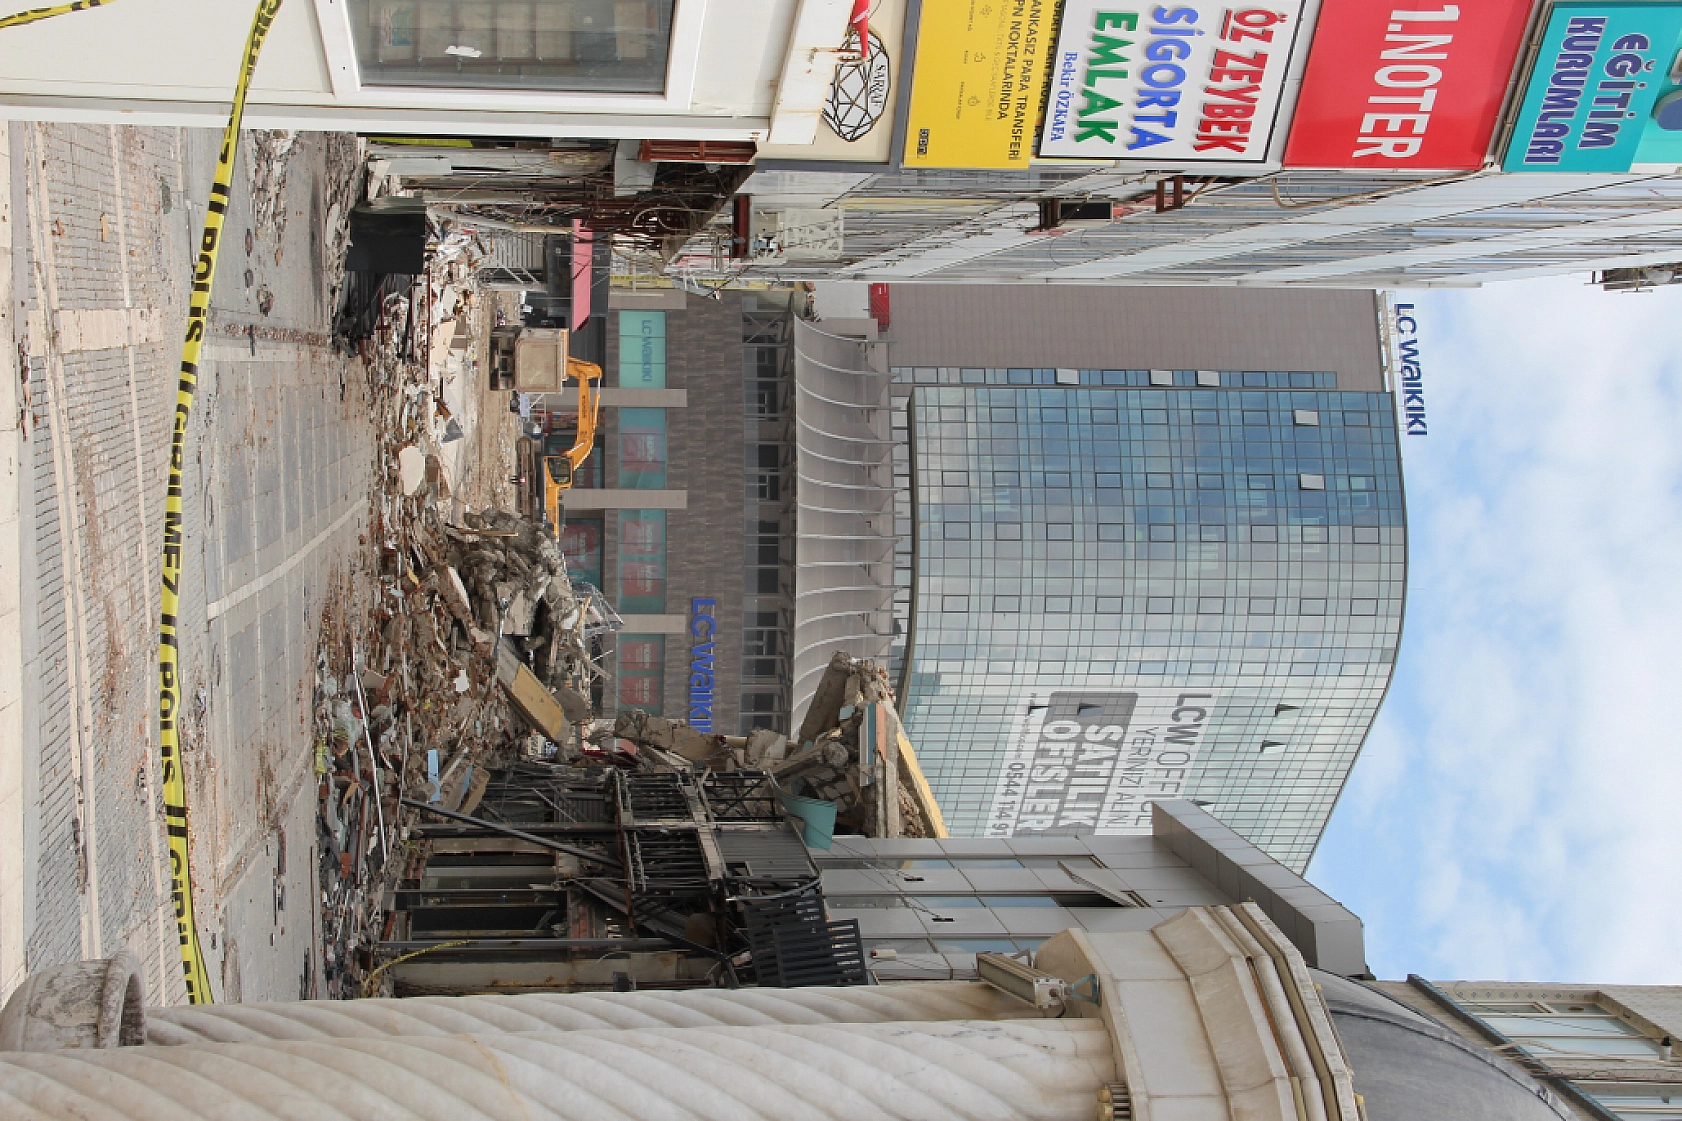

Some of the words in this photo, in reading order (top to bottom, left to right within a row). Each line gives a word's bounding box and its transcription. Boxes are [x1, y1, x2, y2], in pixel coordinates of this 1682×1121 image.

[1230, 9, 1288, 43] ÖZ
[996, 21, 1022, 121] NOKTALARINDA
[1017, 59, 1034, 92] PARA
[1060, 52, 1079, 87] Bekir
[1074, 11, 1139, 144] EMLAK
[1127, 6, 1205, 150] SİGORTA
[1193, 49, 1269, 153] ZEYBEK
[1352, 4, 1460, 158] 1.NOTER
[1523, 17, 1608, 165] KURUMLARI
[1577, 34, 1656, 149] EĞİTİM
[1008, 95, 1028, 160] TRANSFERİ
[1050, 90, 1074, 142] ÖZKAFA
[1394, 303, 1417, 335] LC
[691, 597, 717, 637] LC
[1164, 694, 1212, 746] LCW
[1001, 762, 1026, 797] 0544
[1015, 720, 1082, 831] OFİSLER
[1057, 724, 1124, 828] SATILIK
[1117, 727, 1159, 789] YERİNİZİ
